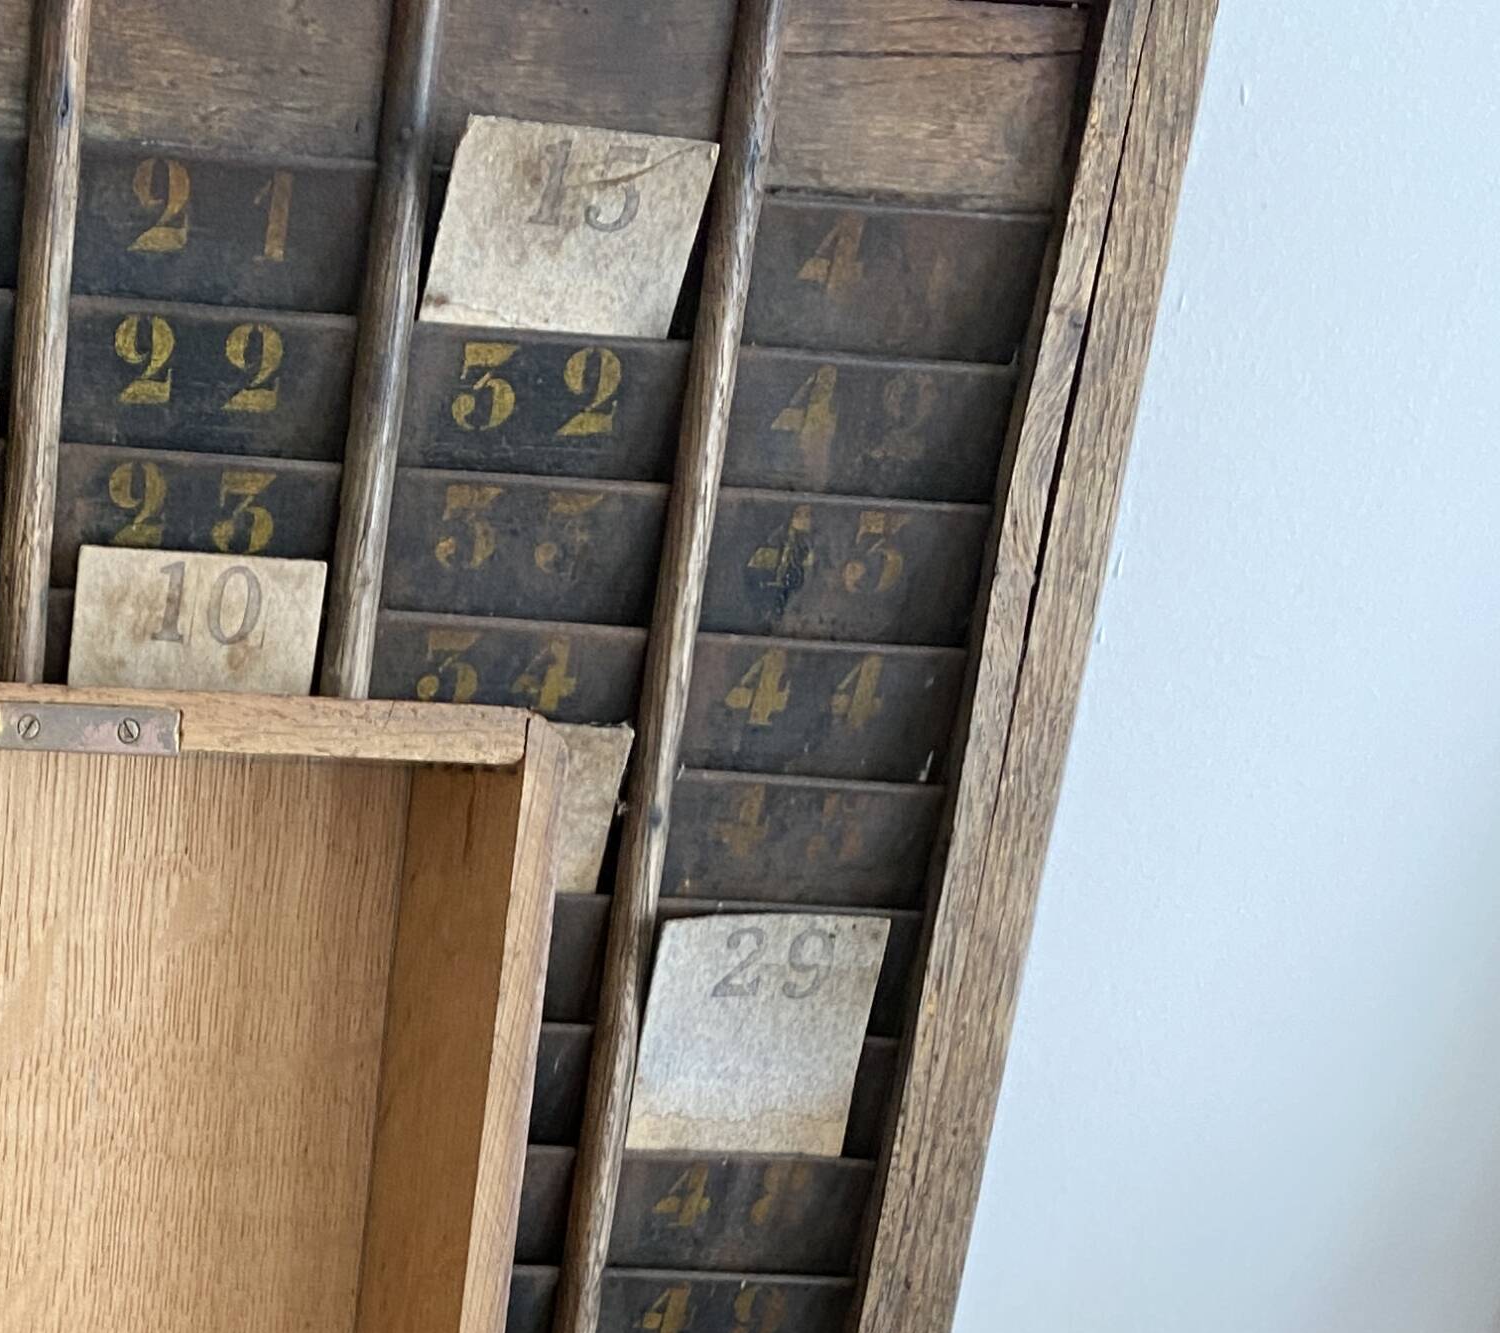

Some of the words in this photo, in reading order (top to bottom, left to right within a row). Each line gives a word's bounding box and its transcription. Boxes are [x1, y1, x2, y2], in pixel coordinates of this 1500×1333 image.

[127, 158, 292, 262] 21
[524, 139, 650, 233] 15
[114, 315, 284, 412] 22
[451, 341, 622, 437] 32
[108, 462, 278, 553] 23
[150, 562, 262, 646] 10
[725, 648, 883, 727] 44
[711, 926, 834, 1000] 29
